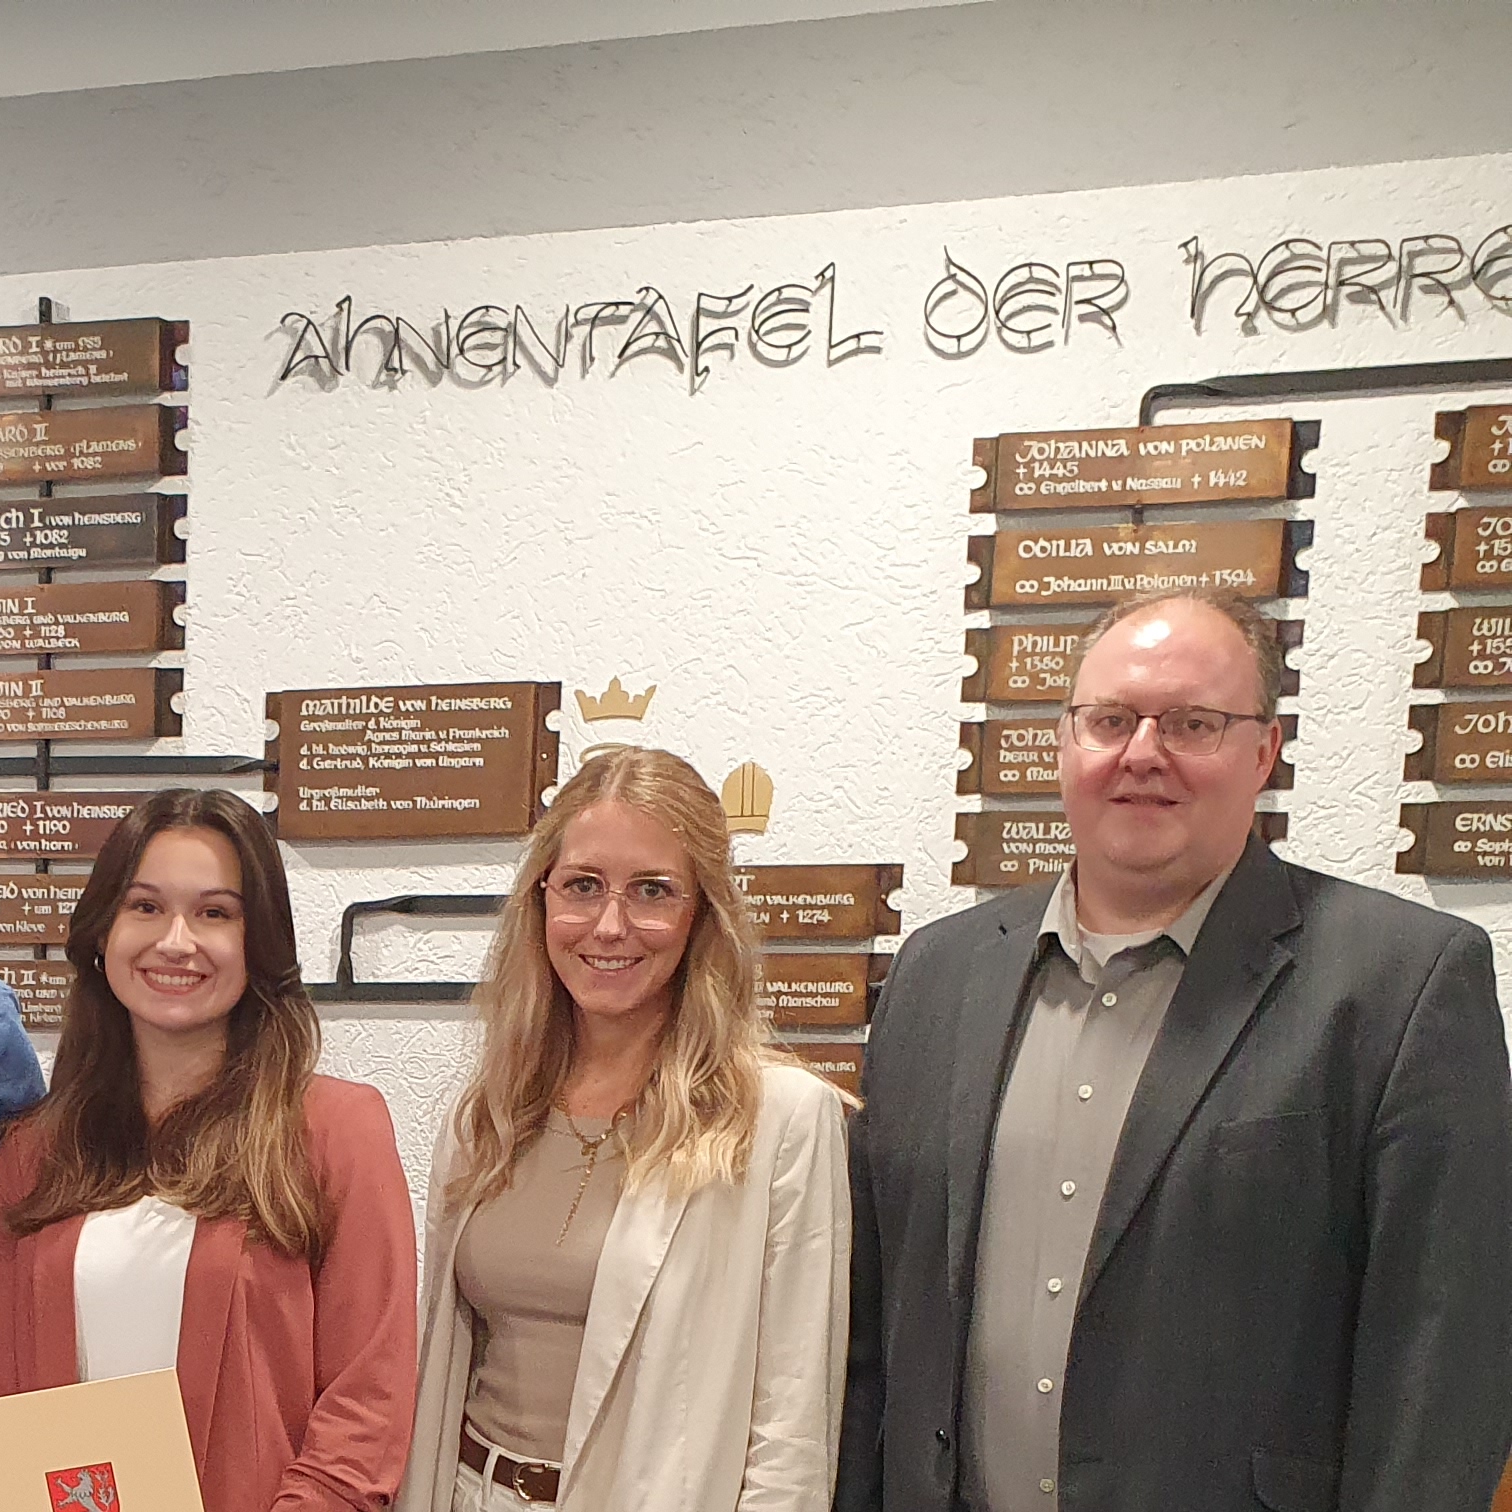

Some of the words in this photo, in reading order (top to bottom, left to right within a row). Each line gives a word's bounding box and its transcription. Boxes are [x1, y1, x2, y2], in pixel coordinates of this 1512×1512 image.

[1015, 438, 1131, 463] JOHANNA
[1138, 441, 1175, 456] VON
[1179, 433, 1267, 457] POLANEN
[1018, 537, 1094, 559] ODILIA
[1102, 541, 1140, 557] VON
[1012, 633, 1080, 656] PHILIP
[300, 695, 394, 716] MATHILDE
[1002, 821, 1072, 840] WALRA
[1002, 842, 1033, 854] VON
